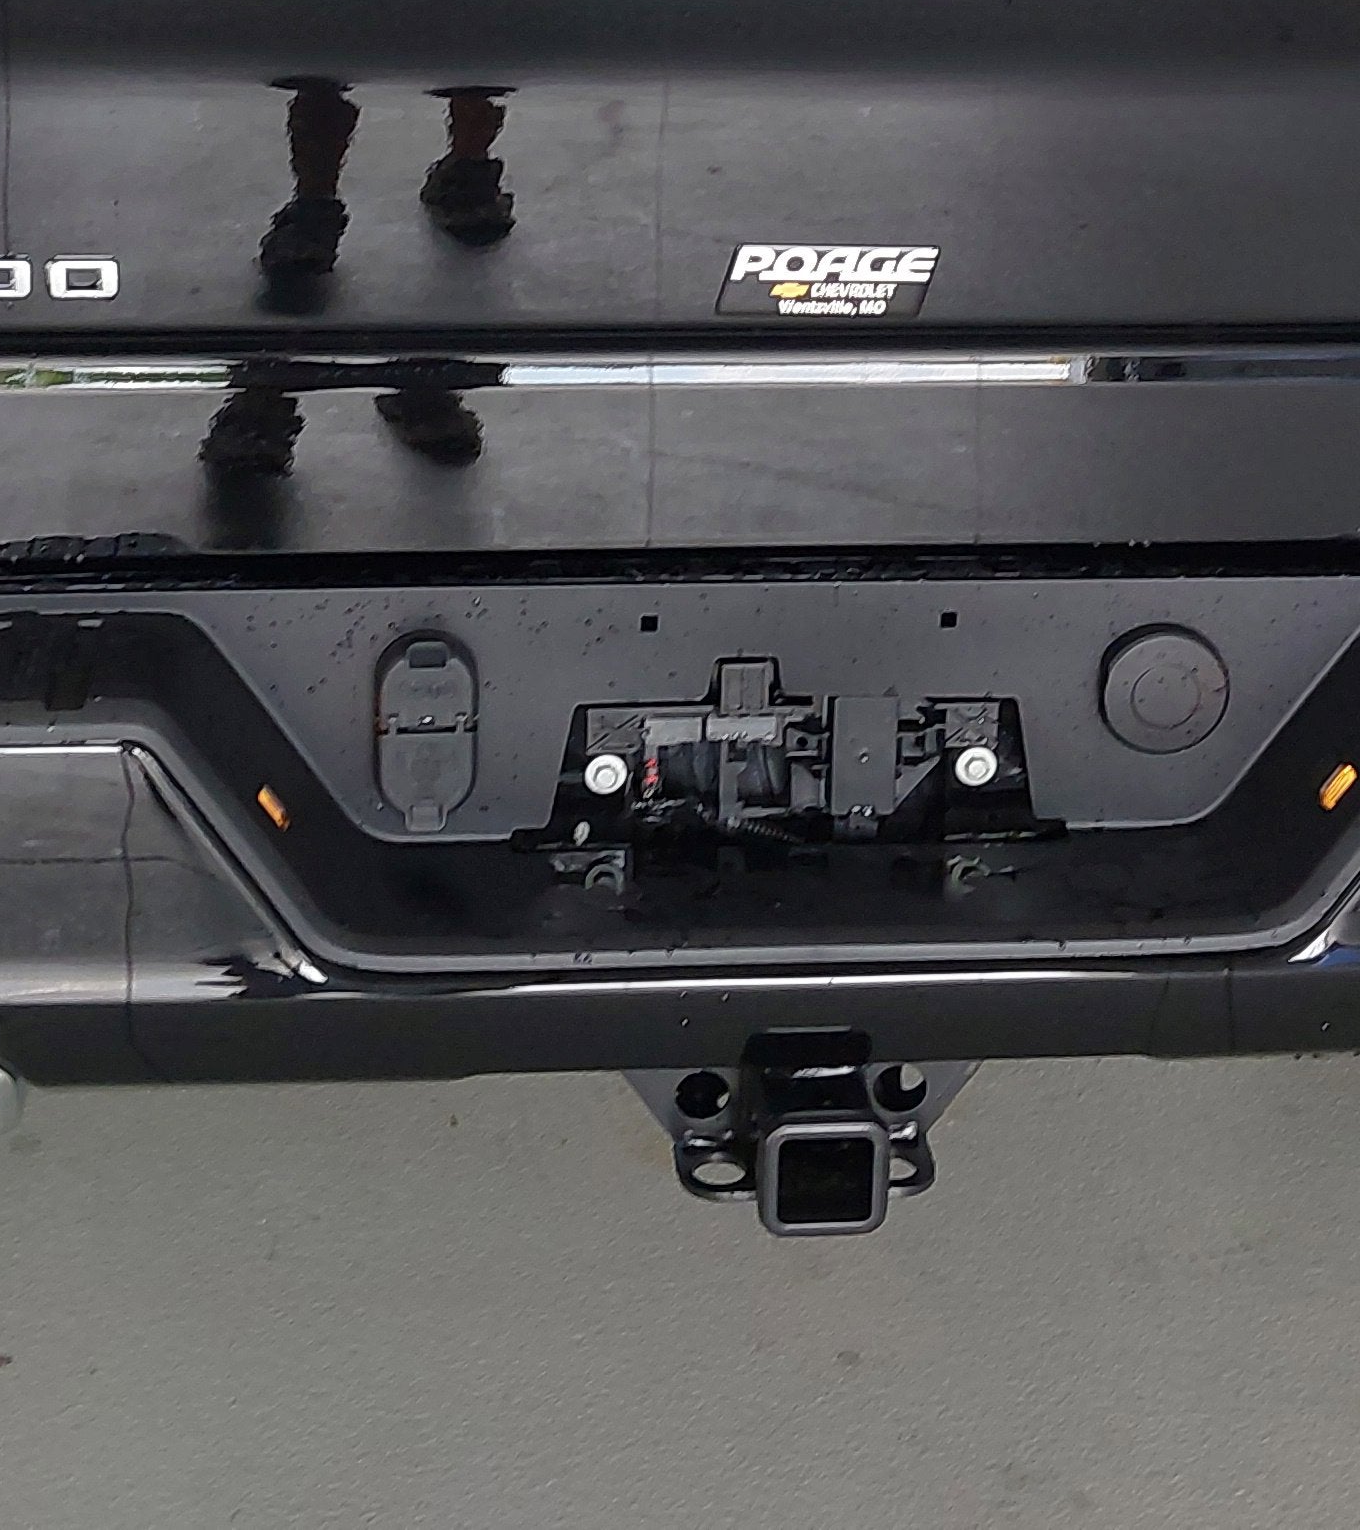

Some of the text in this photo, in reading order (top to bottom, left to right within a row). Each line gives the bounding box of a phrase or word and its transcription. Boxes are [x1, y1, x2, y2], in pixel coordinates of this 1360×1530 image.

[729, 245, 940, 283] POAGE
[810, 282, 898, 299] CHEVROLET
[858, 301, 887, 316] MO
